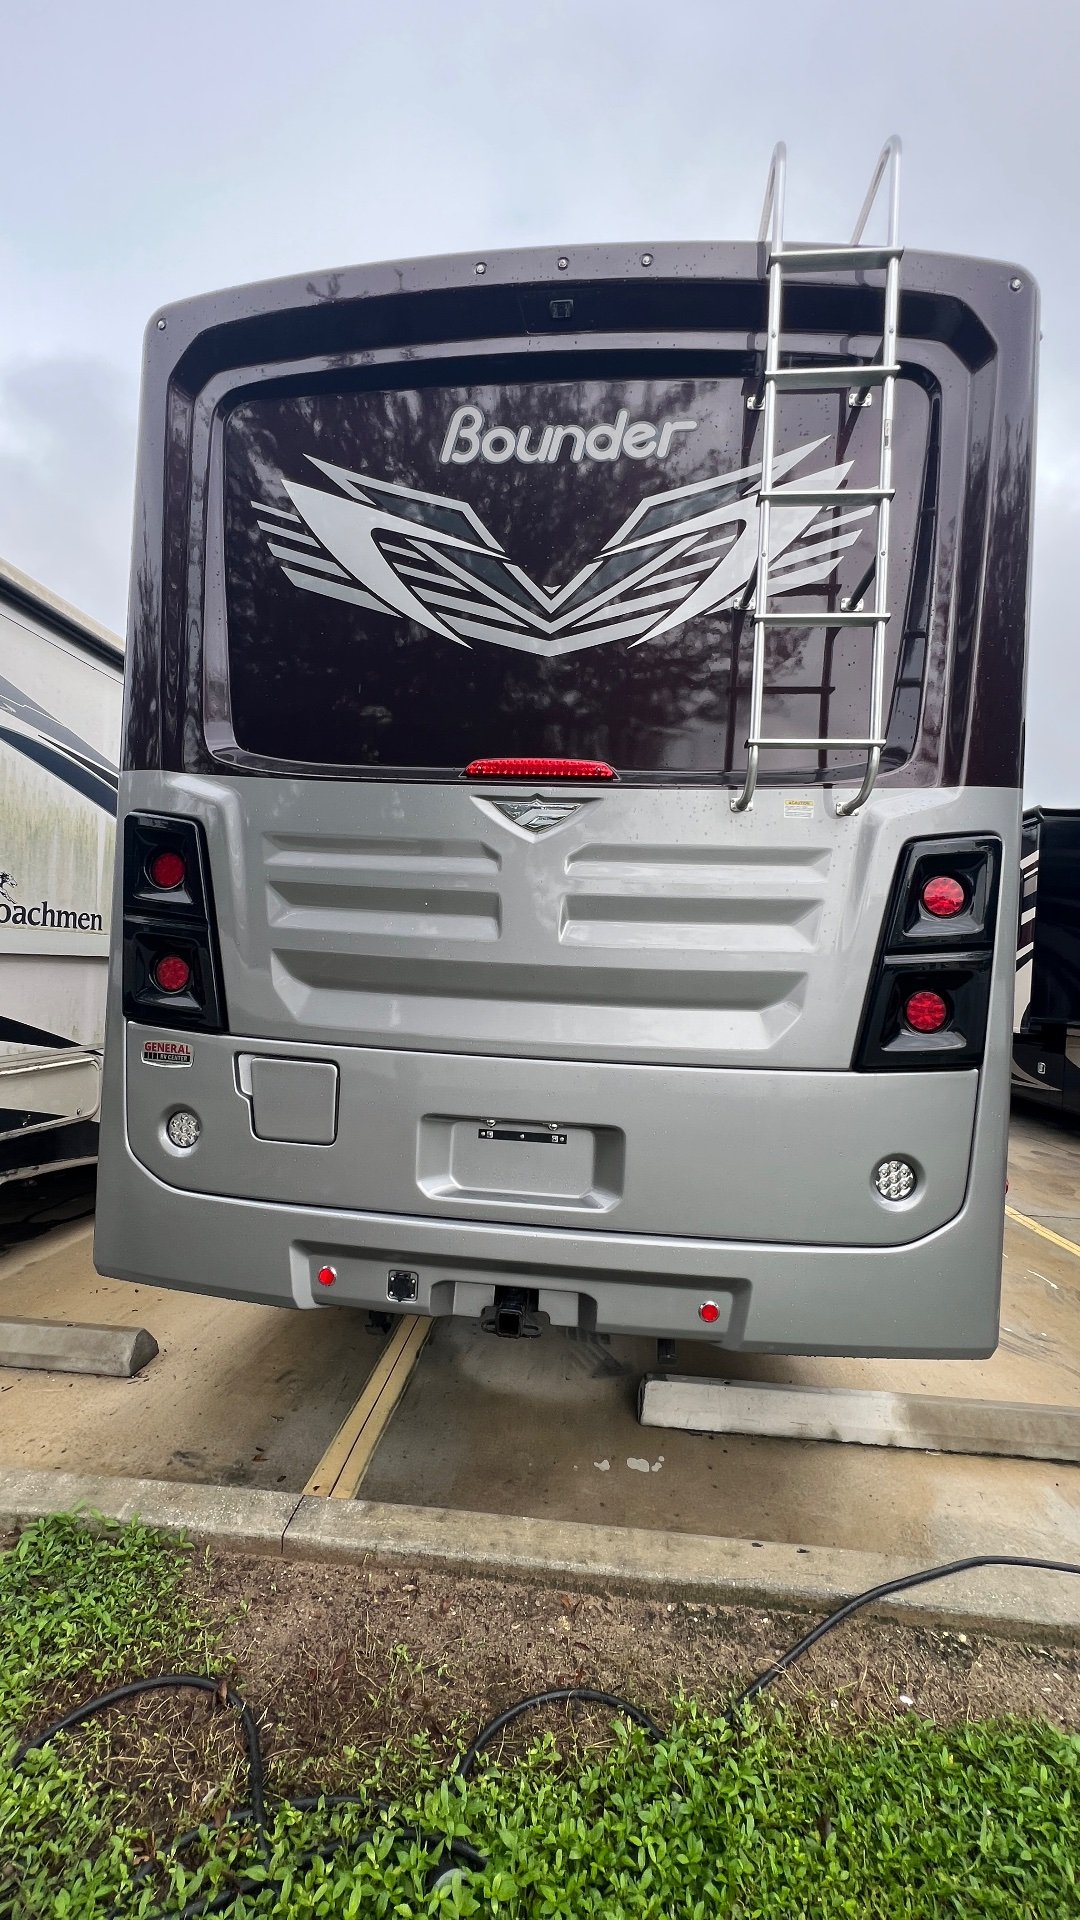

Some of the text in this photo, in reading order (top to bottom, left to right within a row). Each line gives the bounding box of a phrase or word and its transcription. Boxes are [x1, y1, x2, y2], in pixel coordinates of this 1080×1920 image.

[439, 405, 698, 464] Bounder
[144, 1041, 191, 1054] GENERAL
[167, 1054, 188, 1062] CENTER
